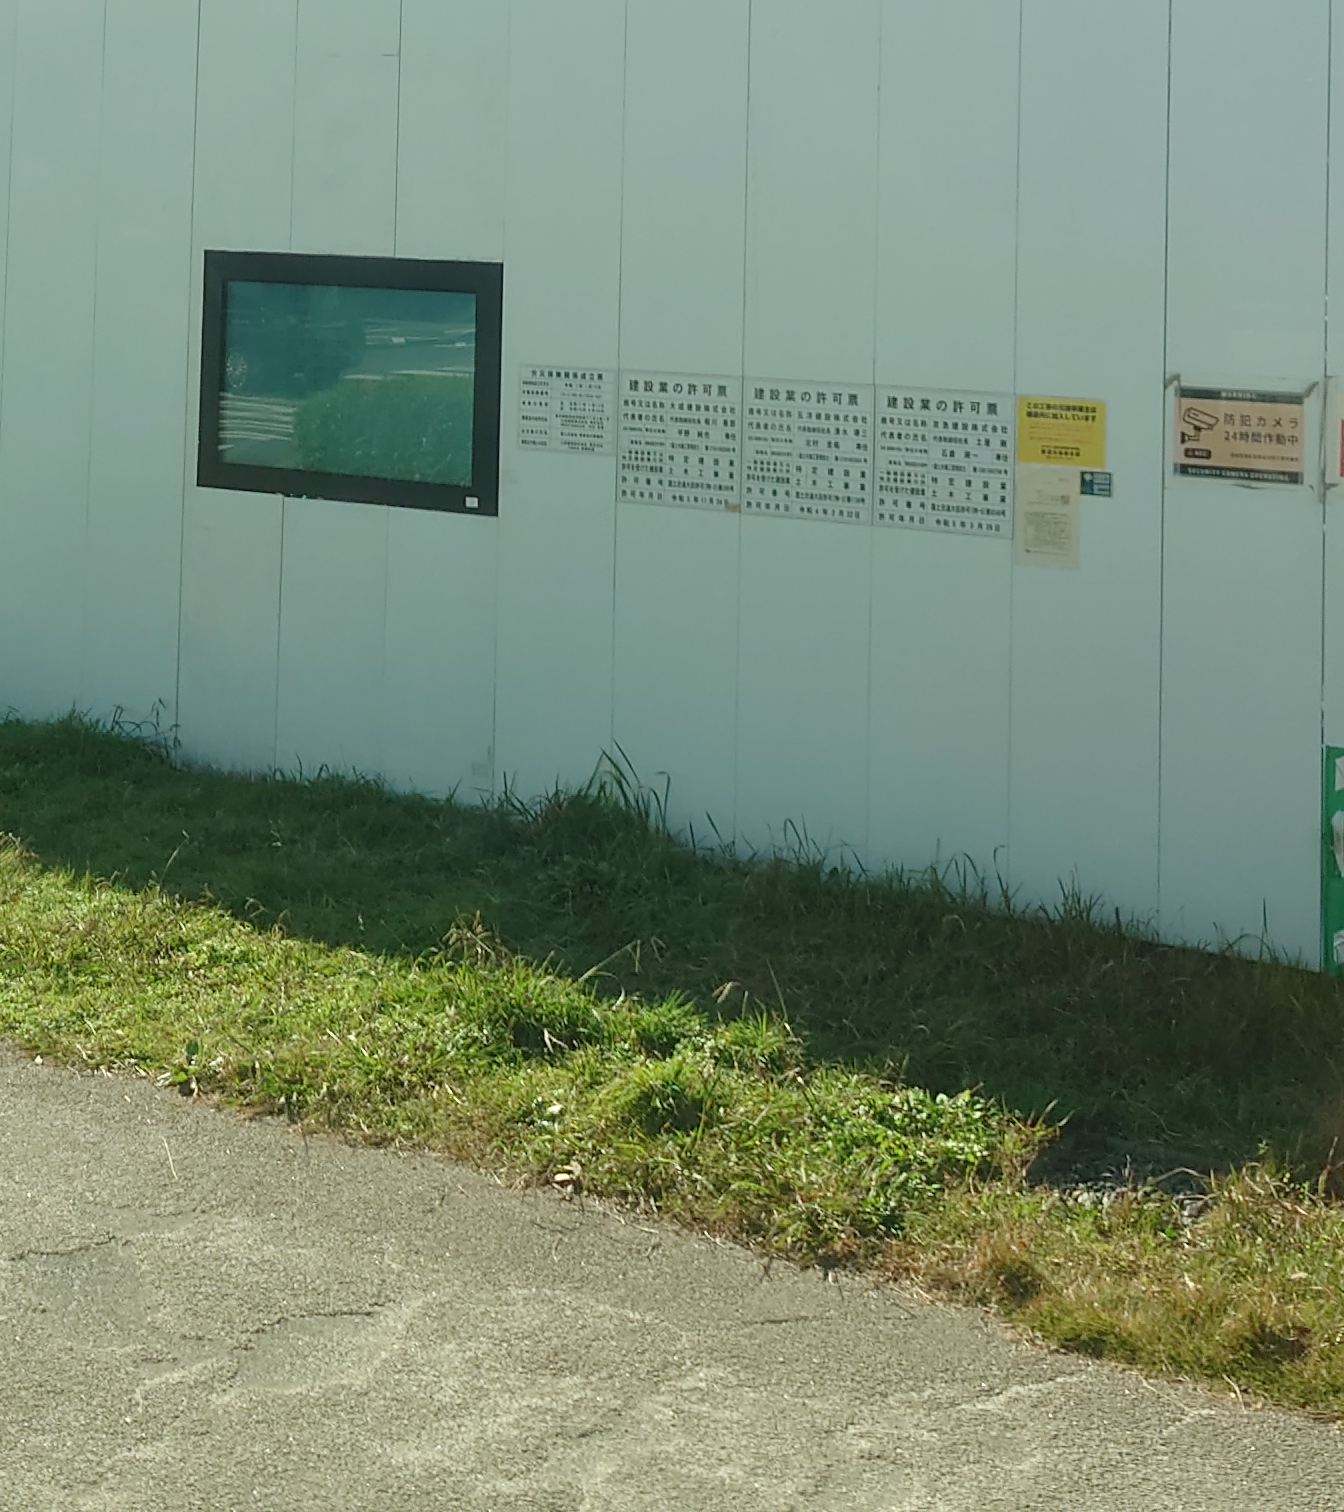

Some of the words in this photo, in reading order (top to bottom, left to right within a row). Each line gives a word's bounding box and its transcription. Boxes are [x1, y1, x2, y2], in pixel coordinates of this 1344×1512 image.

[629, 379, 727, 398] 建設業の許可票
[754, 387, 859, 406] 建設業の許可票
[887, 395, 998, 416] 建設業の許可票
[1223, 413, 1299, 429] 防犯カメラ
[1223, 431, 1299, 446] 24時間作動中
